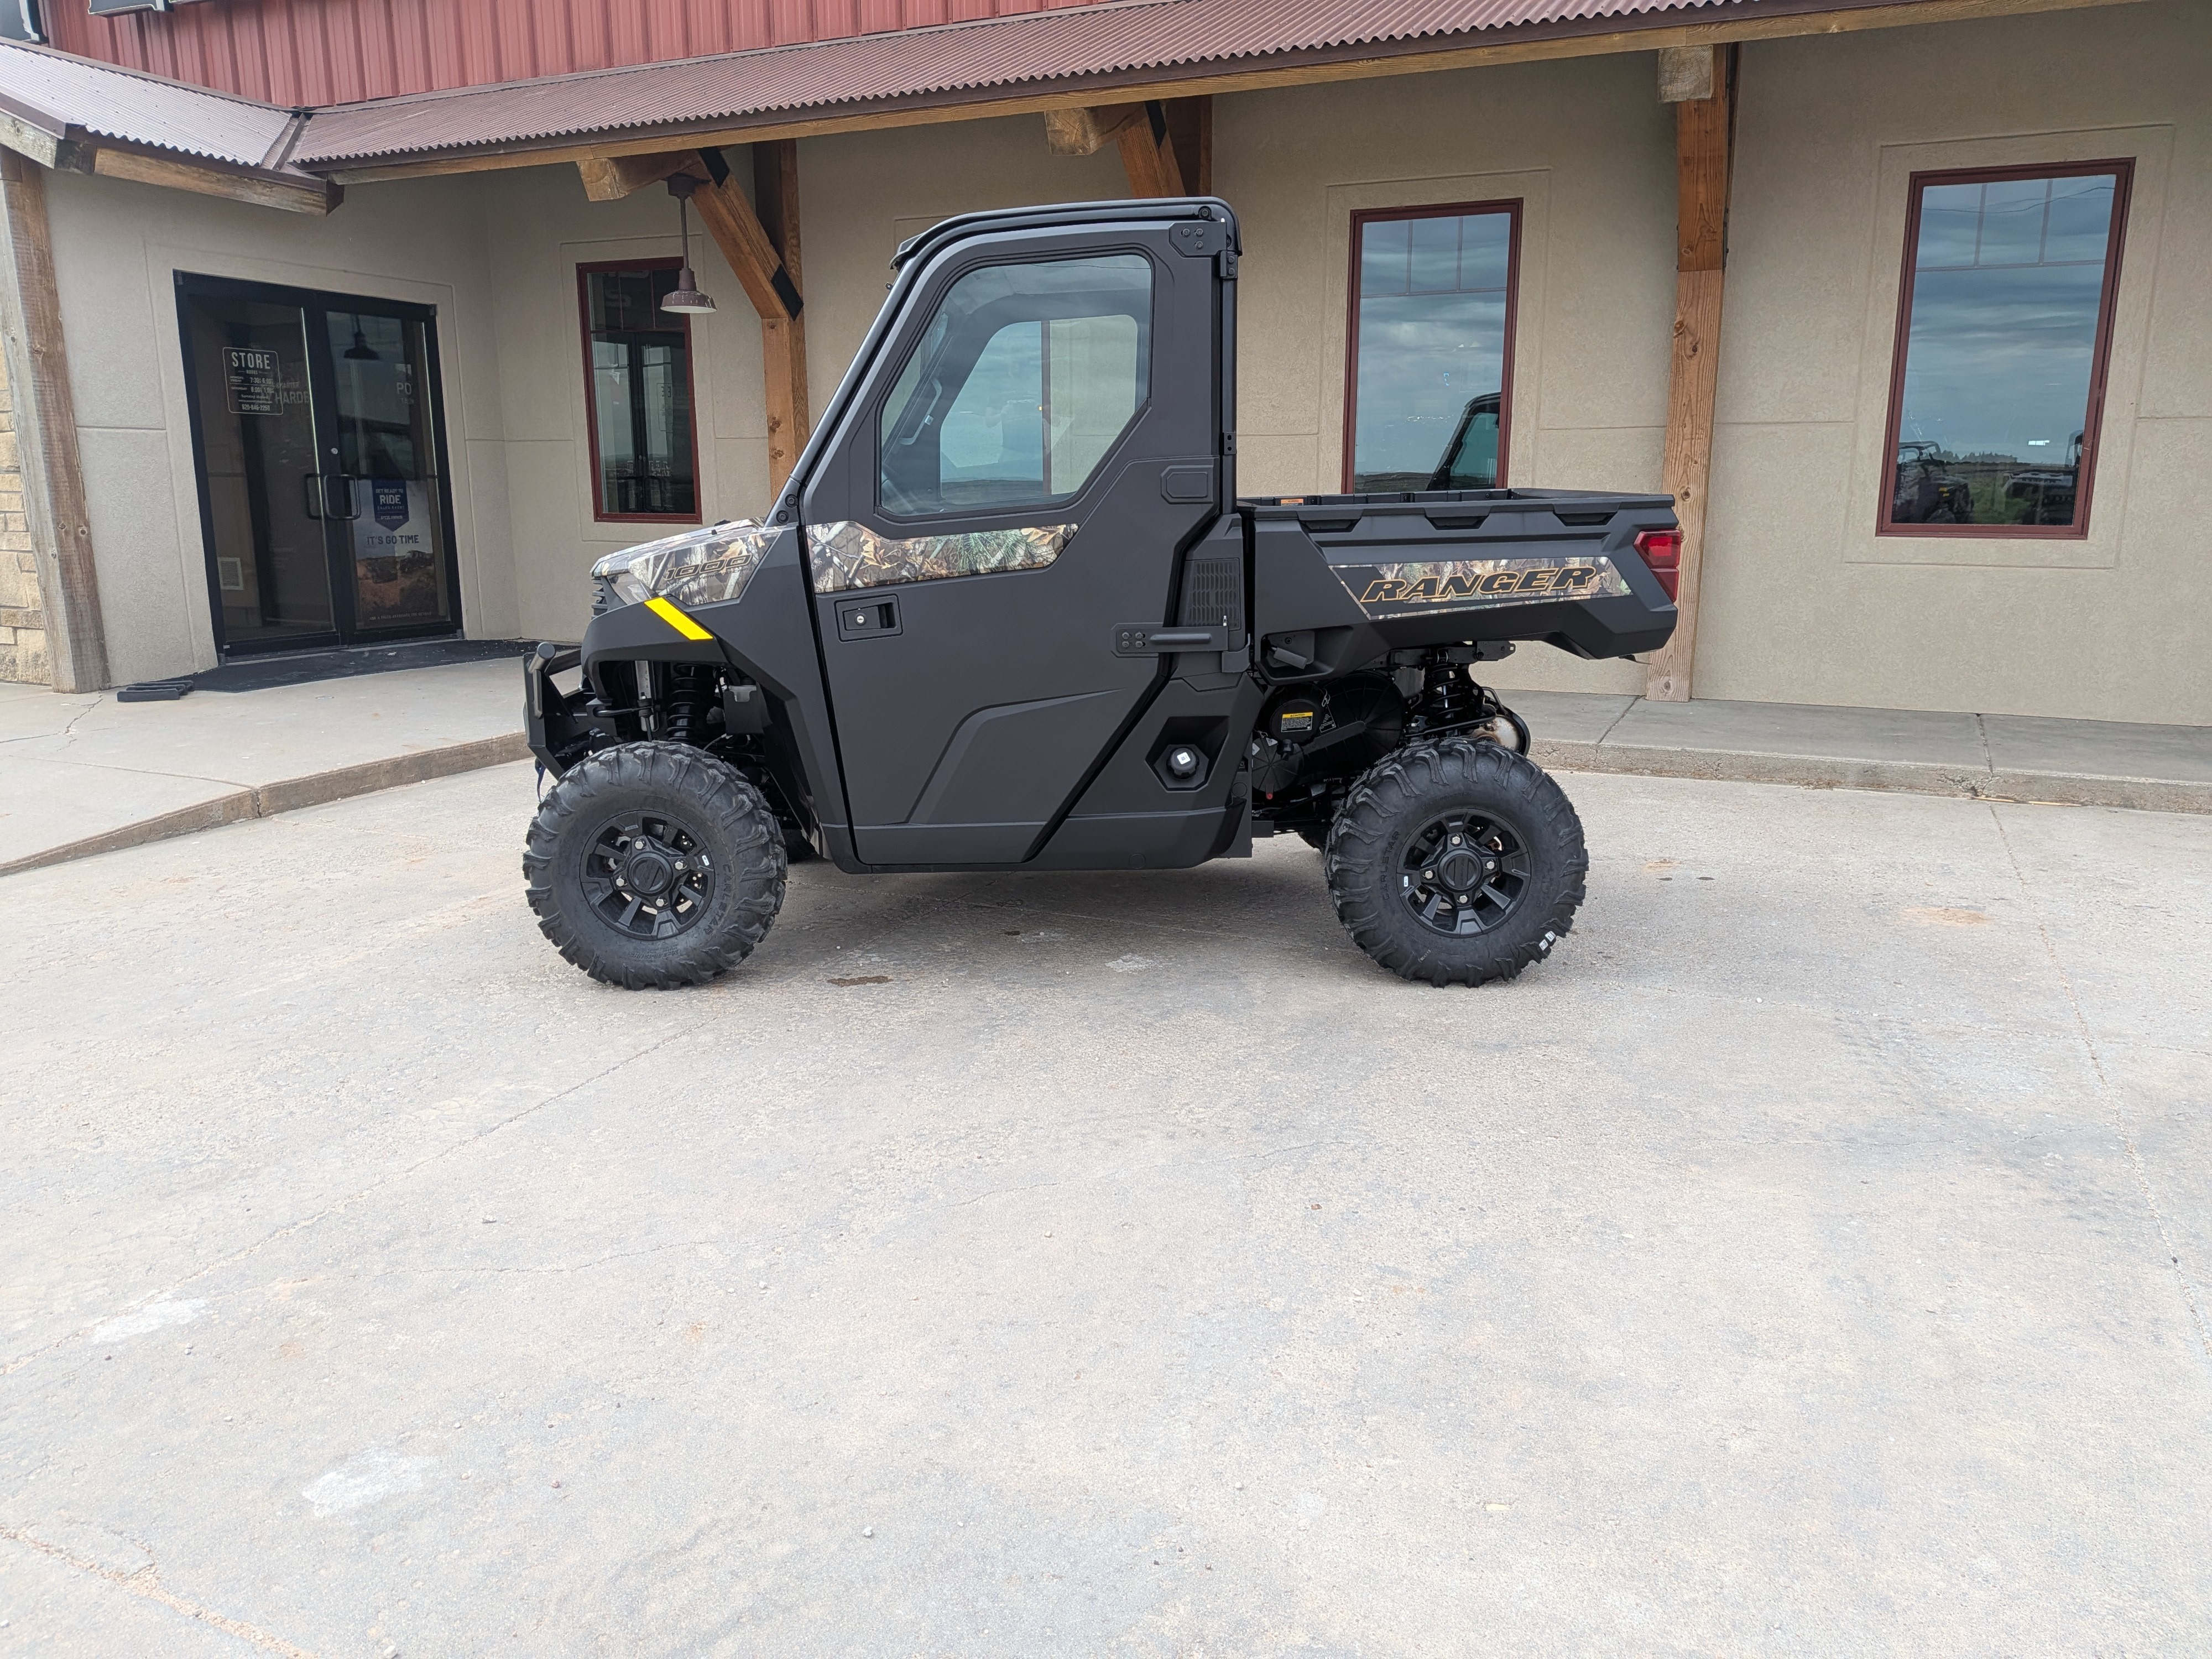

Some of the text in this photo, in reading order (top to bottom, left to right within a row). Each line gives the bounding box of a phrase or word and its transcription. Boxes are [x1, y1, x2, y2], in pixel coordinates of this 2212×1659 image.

[231, 352, 270, 369] STORE
[396, 382, 413, 395] PO
[379, 494, 401, 505] RIDE
[367, 535, 419, 545] IT'S GO TIME
[664, 554, 754, 581] 1000
[1360, 567, 1597, 603] RANGER
[1380, 831, 1401, 900] CARLSTAR
[703, 864, 732, 935] CARLSTAR
